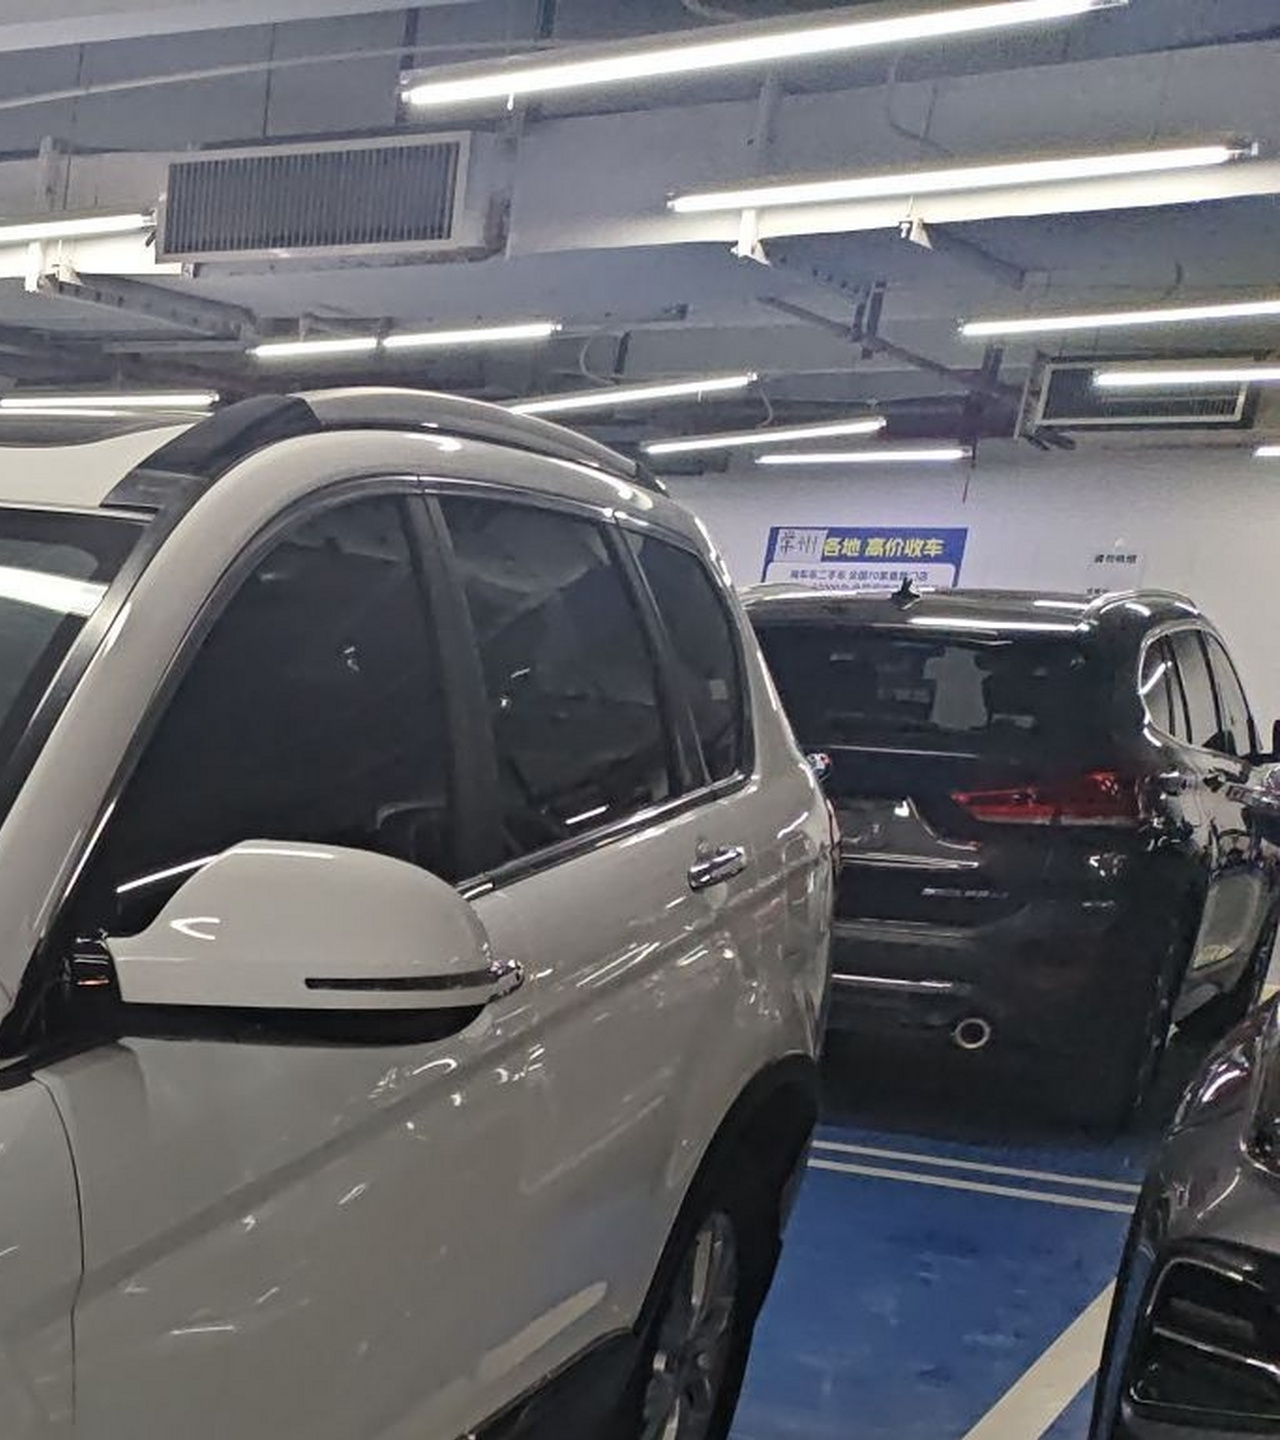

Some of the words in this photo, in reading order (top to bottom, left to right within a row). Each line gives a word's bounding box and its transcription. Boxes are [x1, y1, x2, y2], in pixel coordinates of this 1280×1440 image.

[823, 538, 861, 557] 各地
[865, 538, 944, 558] 高价收车
